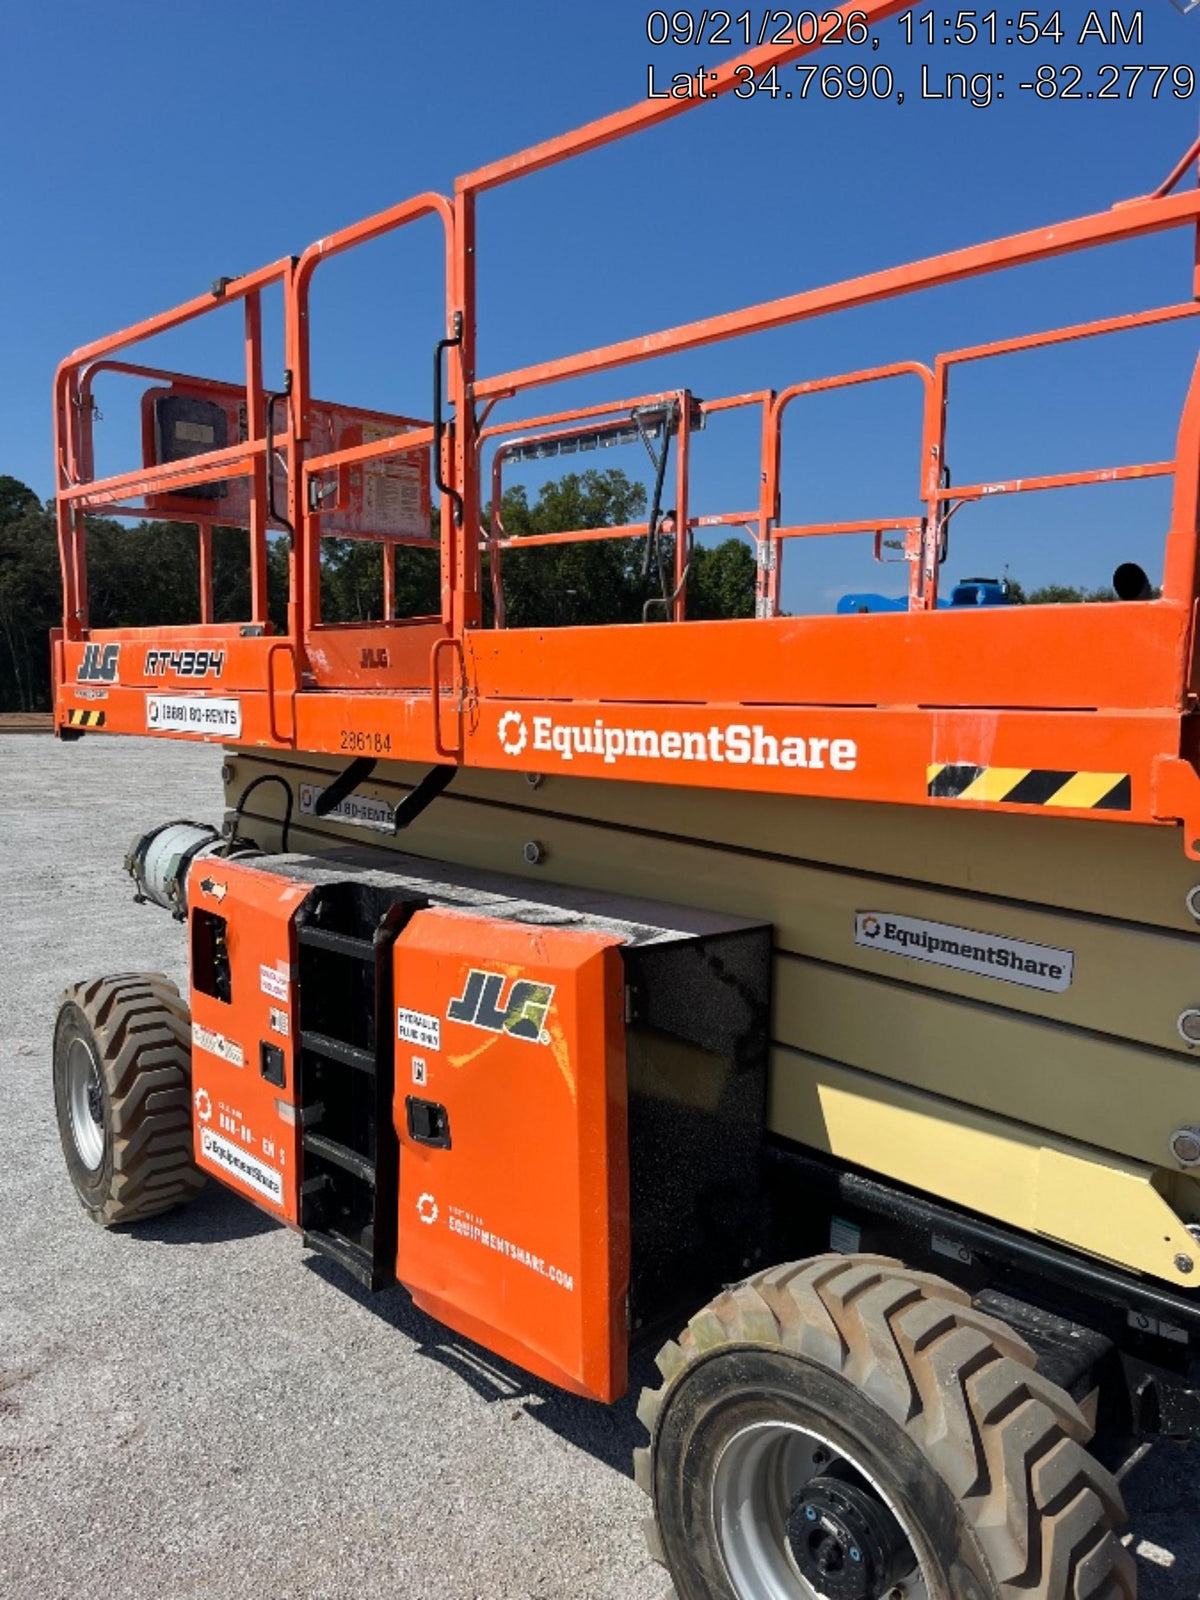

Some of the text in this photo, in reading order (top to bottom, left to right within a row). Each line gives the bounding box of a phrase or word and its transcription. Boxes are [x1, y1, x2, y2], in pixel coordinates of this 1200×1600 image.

[77, 642, 121, 683] JLG
[144, 650, 225, 678] RT4394
[532, 716, 858, 771] EquipmentShare
[883, 921, 1063, 980] EquipmentShare
[446, 968, 556, 1044] JLG
[448, 1215, 574, 1291] EQUIPMENTSHARE.COM
